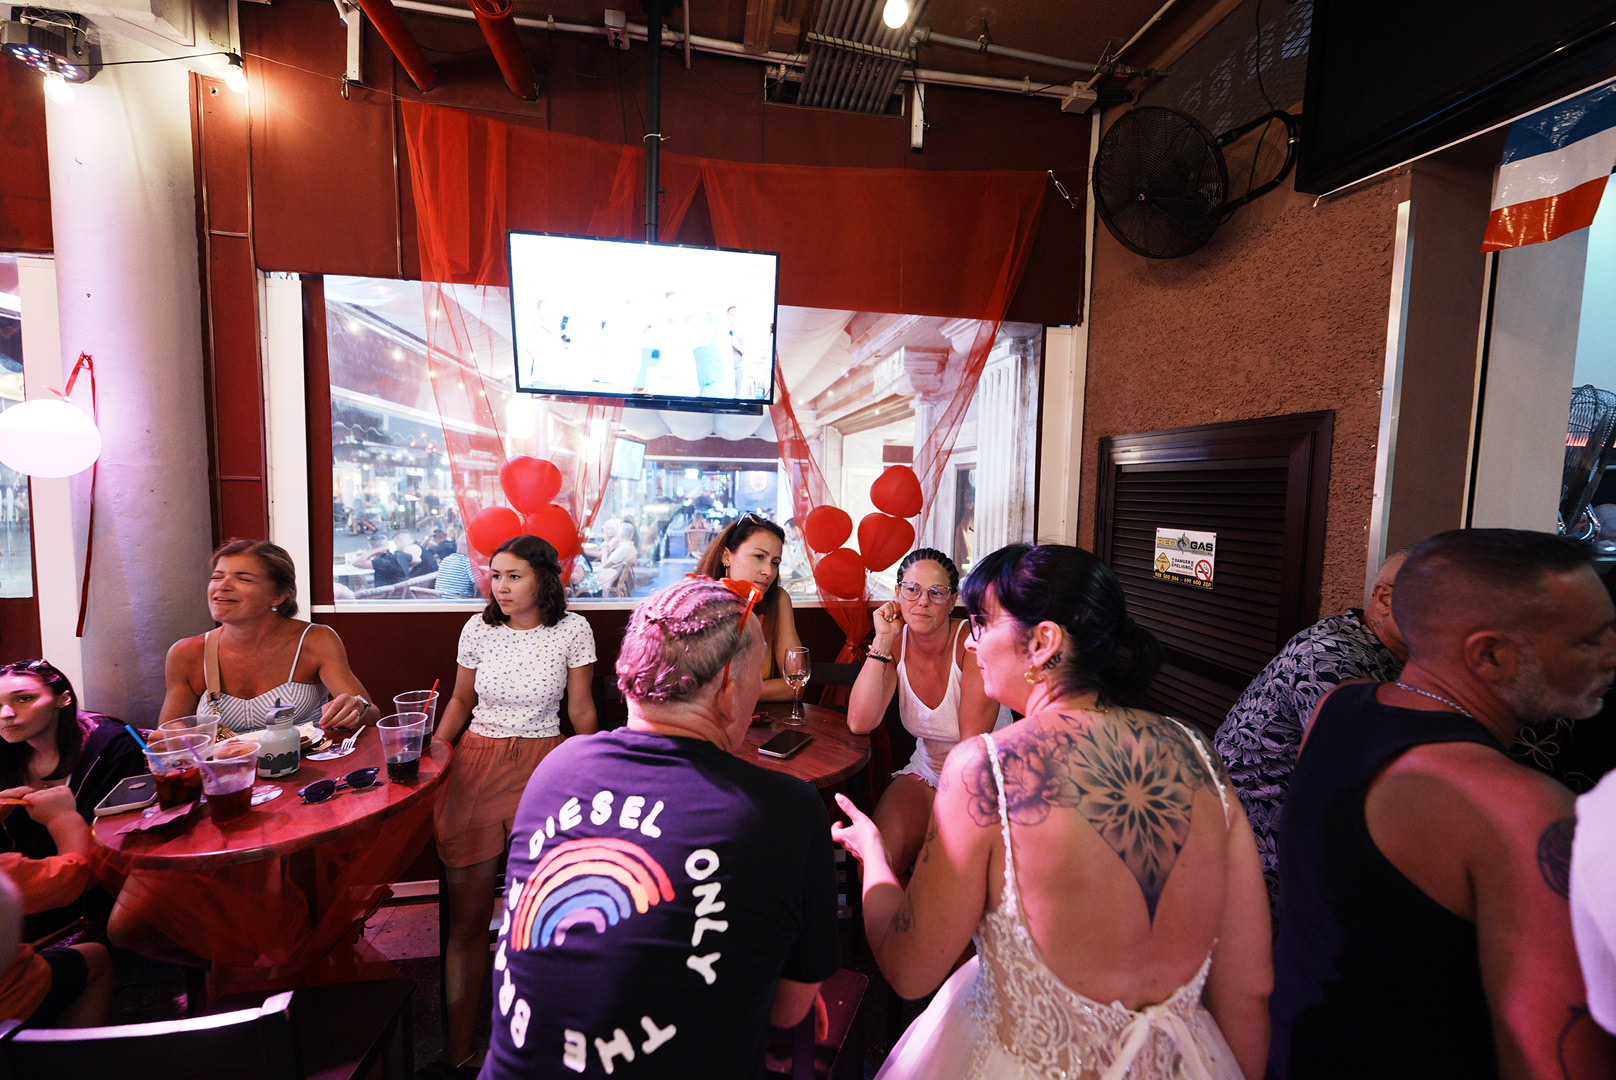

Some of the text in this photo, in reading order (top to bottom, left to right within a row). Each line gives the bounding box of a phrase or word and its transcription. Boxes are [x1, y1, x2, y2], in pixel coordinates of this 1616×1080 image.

[1157, 538, 1213, 551] RED GAS
[529, 790, 665, 860] DIESEL
[685, 849, 728, 985] ONLY
[563, 1016, 677, 1074] THE
